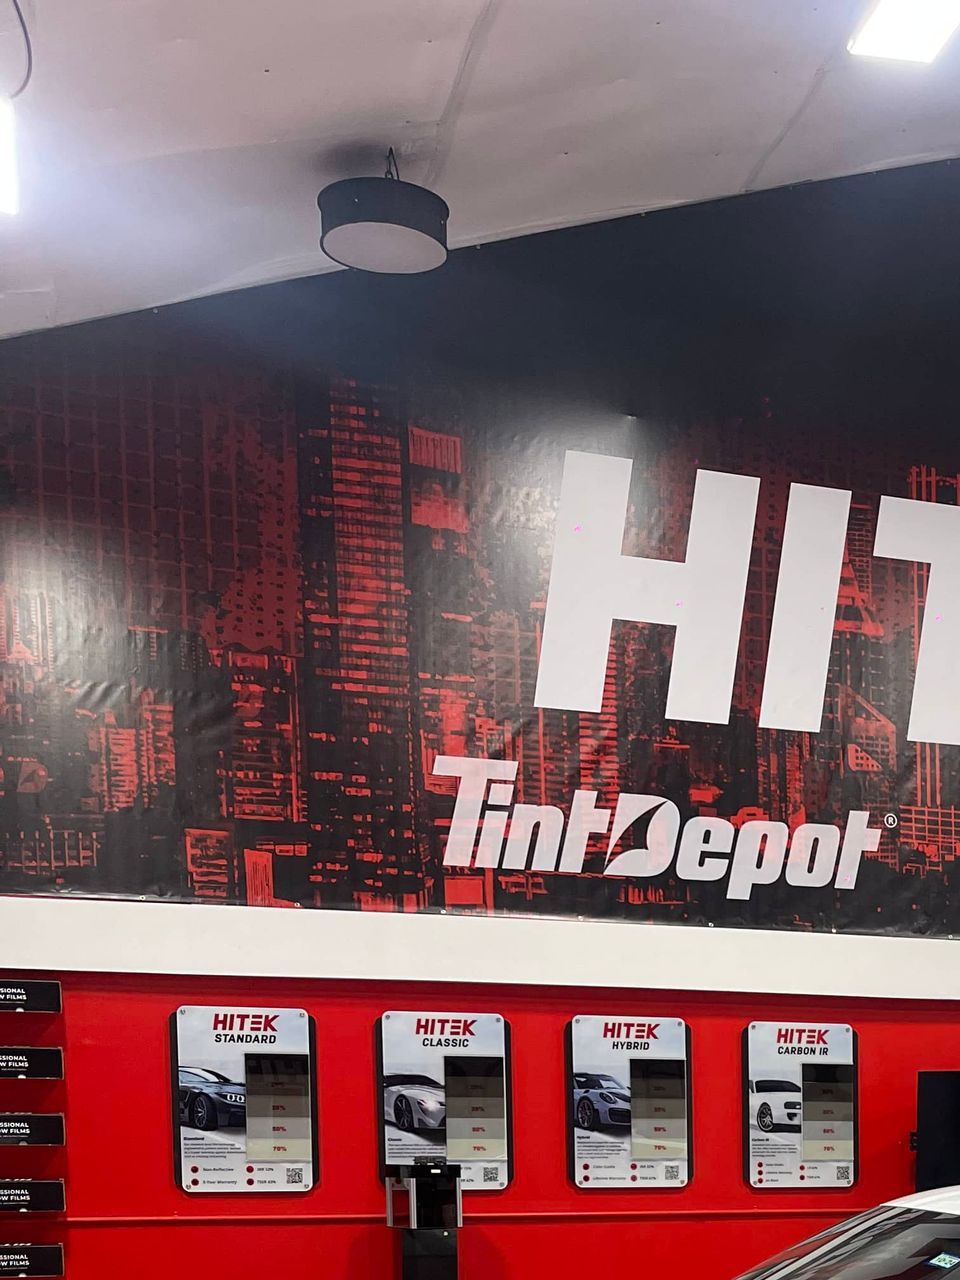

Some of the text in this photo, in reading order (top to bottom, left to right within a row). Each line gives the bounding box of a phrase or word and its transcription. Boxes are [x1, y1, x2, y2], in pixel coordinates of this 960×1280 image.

[213, 1013, 280, 1032] HITEK
[415, 1018, 478, 1036] HITEK
[603, 1022, 661, 1039] HITEK
[777, 1028, 830, 1045] HITEK
[214, 1033, 277, 1044] STANDARD
[422, 1038, 470, 1048] CLASSIC
[612, 1041, 650, 1050] HYBRID
[778, 1046, 829, 1056] CARBON IR
